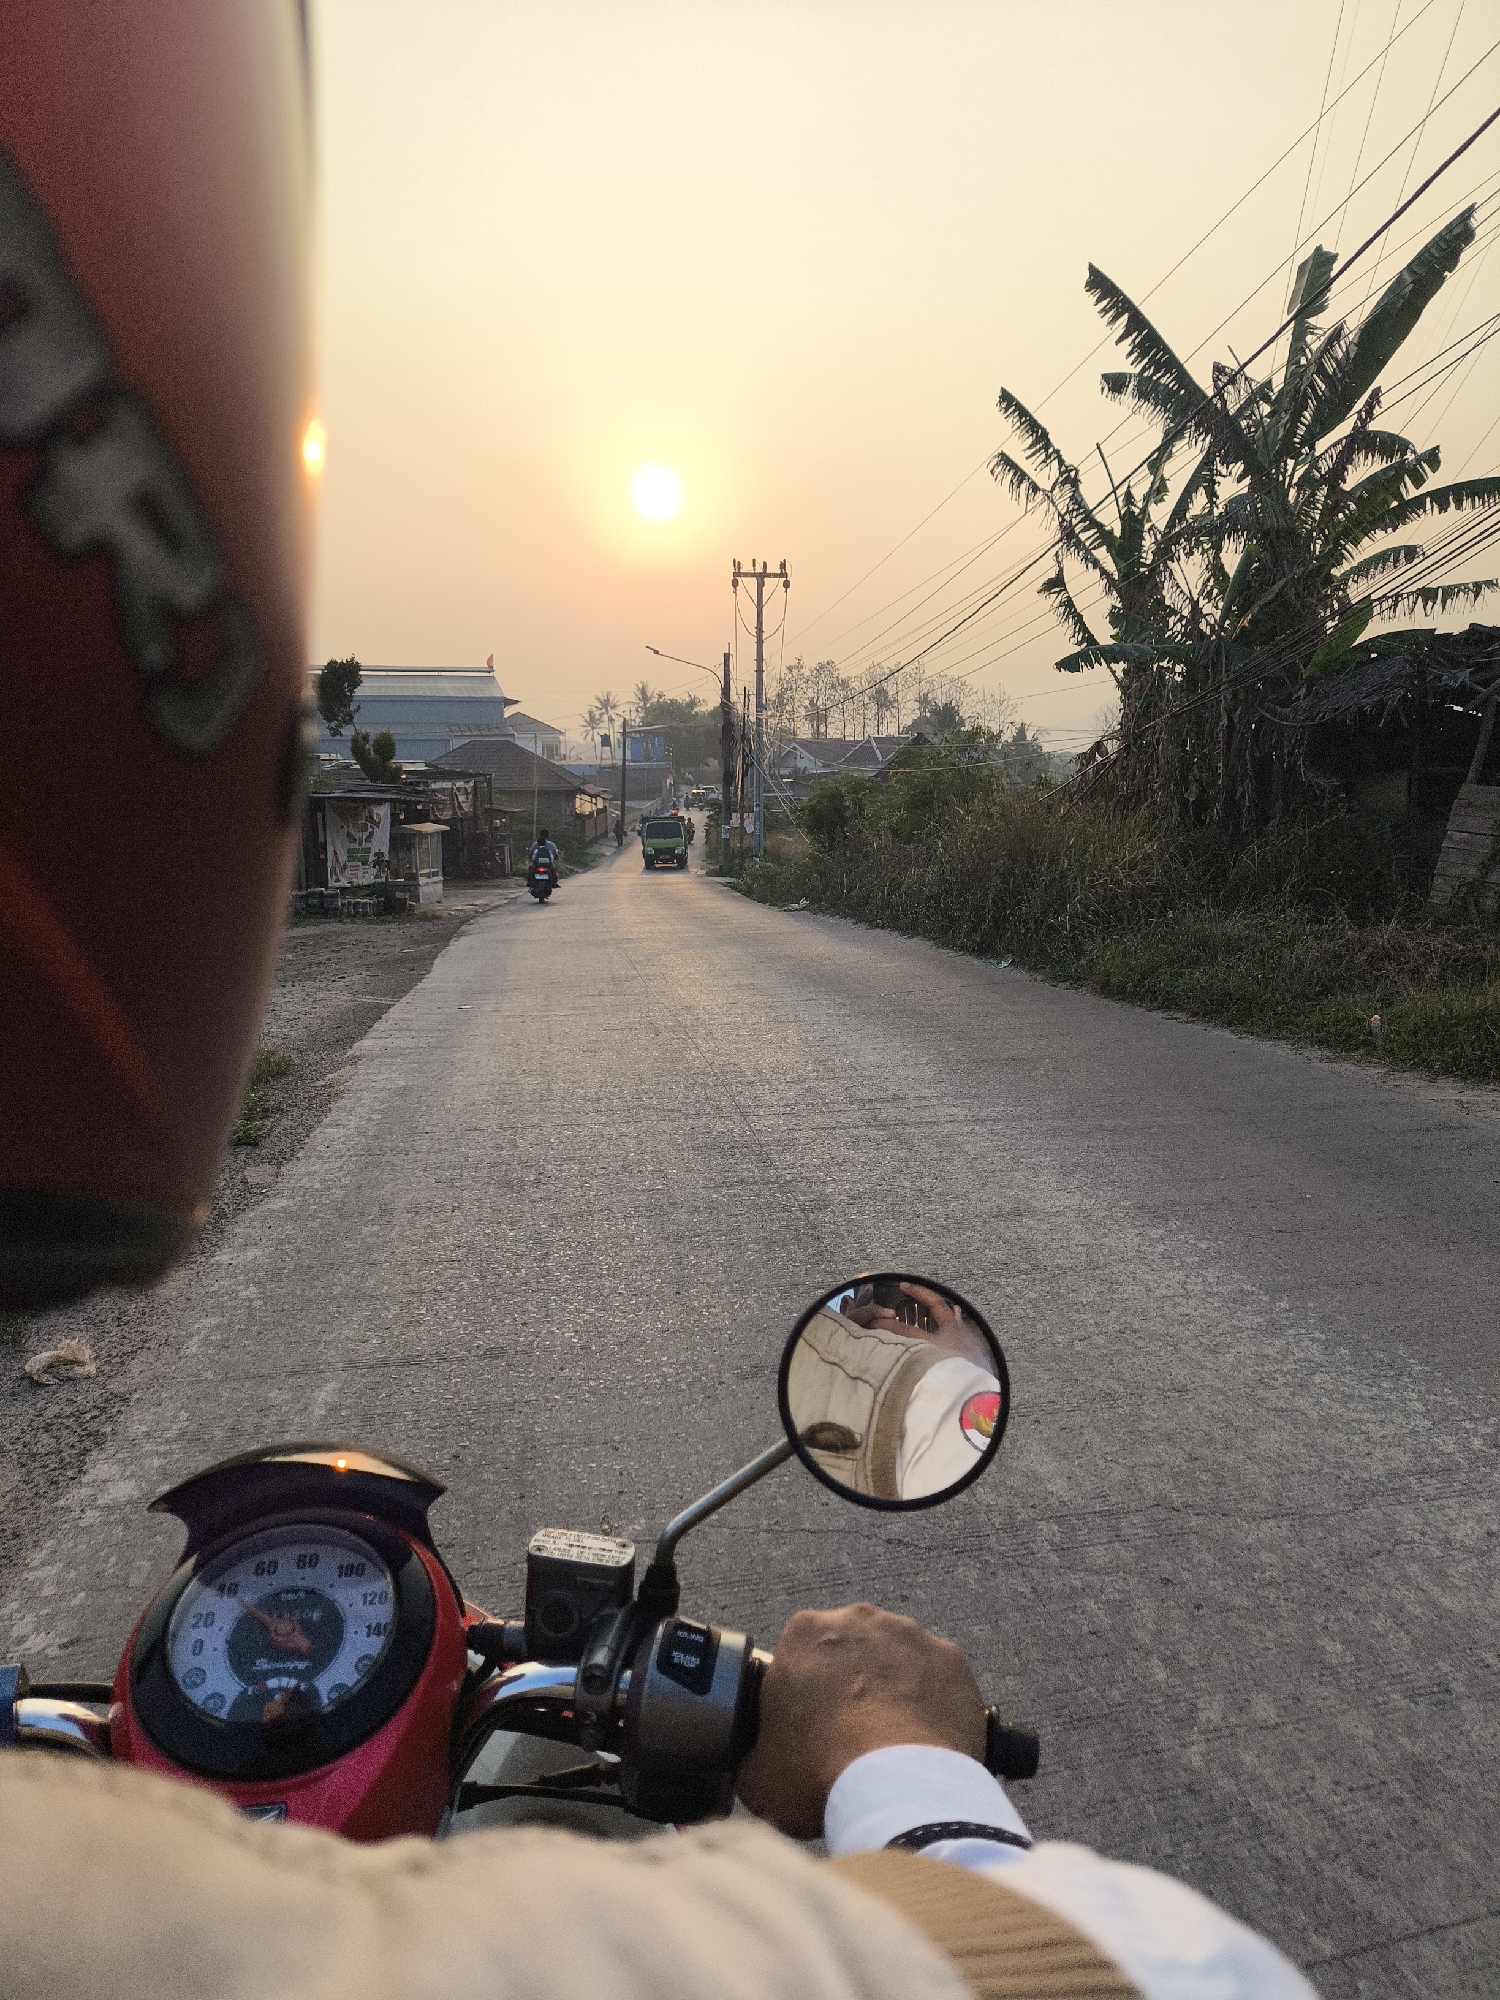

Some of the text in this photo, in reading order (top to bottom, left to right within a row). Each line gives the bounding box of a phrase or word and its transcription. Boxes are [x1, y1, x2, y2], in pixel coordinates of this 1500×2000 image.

[254, 1560, 278, 1576] 60
[337, 1563, 366, 1578] 100
[362, 1591, 389, 1606] 120
[191, 1611, 215, 1629] 20
[191, 1638, 204, 1656] 0
